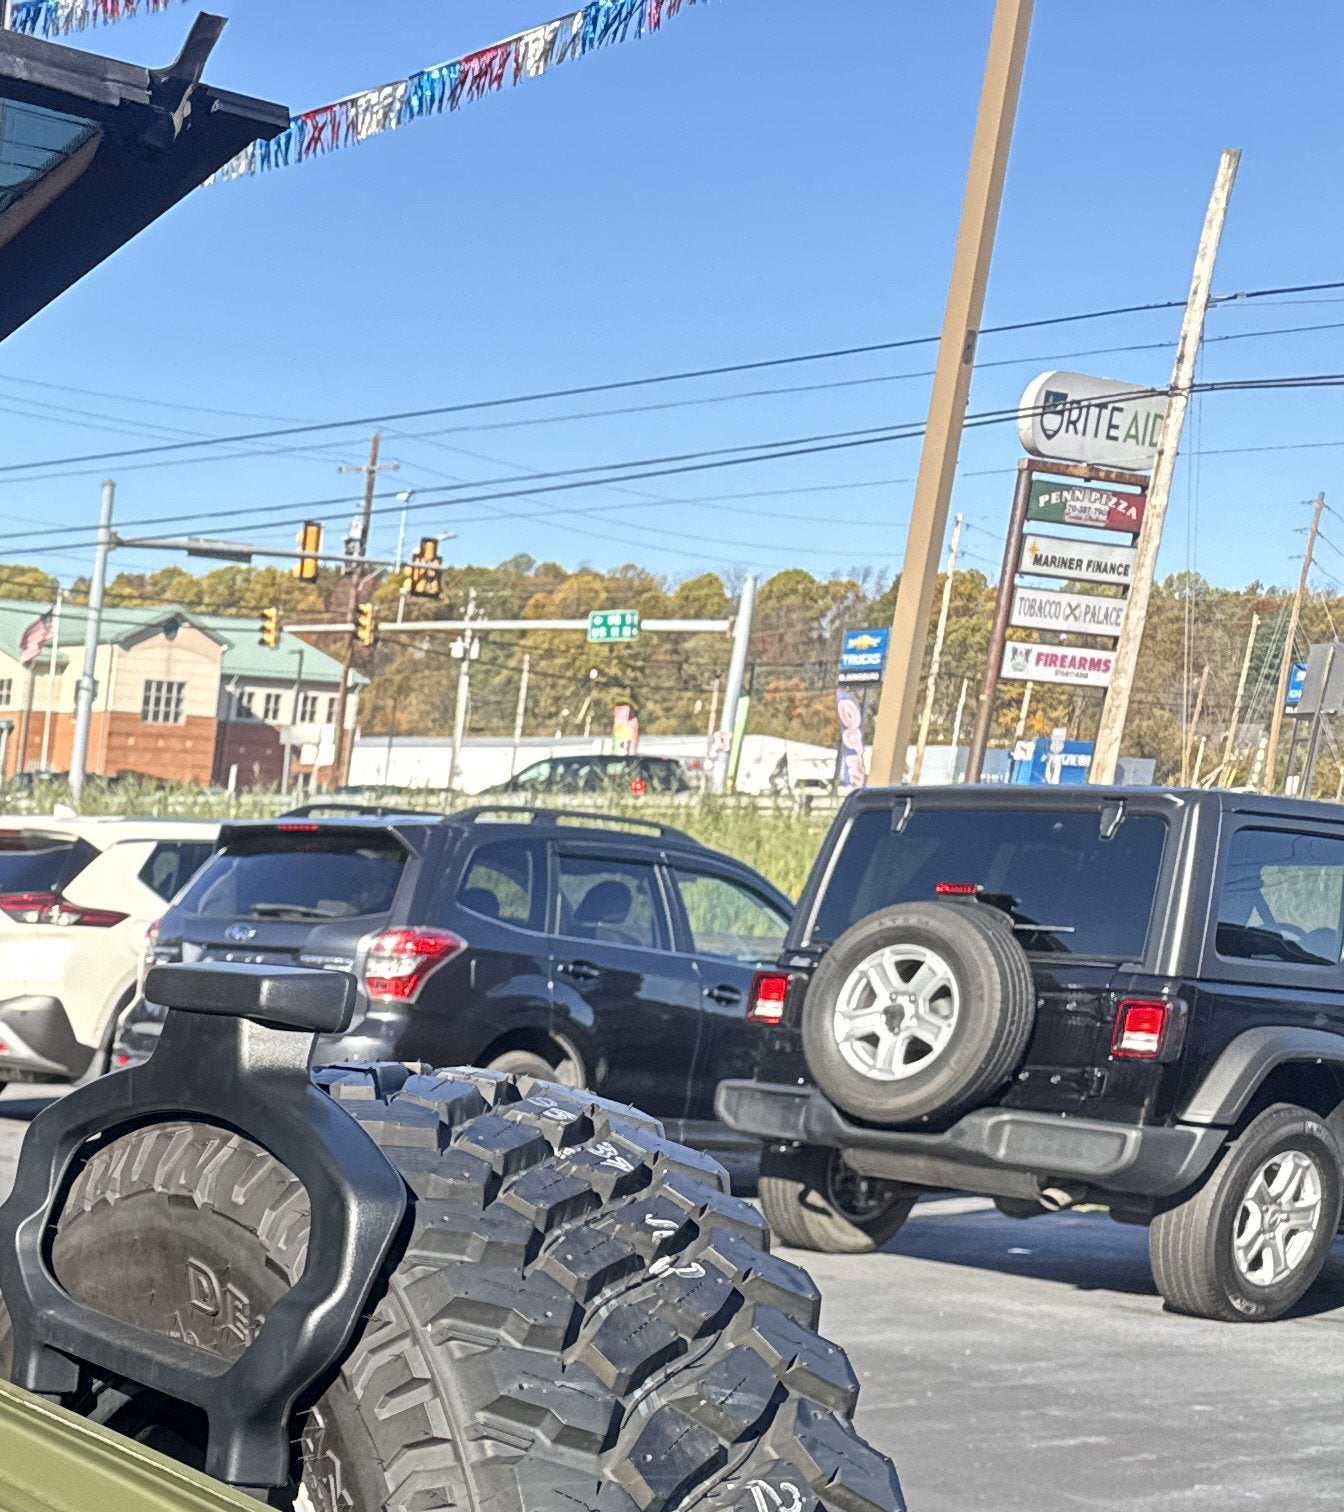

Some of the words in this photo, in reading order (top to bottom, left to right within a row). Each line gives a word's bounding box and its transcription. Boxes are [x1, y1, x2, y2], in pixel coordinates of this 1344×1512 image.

[1065, 399, 1124, 441] RITE
[1038, 489, 1085, 508] PENN
[1090, 491, 1138, 520] PIZZA
[1032, 553, 1083, 572] MARINER
[1086, 559, 1131, 577] FINANCE
[1018, 597, 1062, 620] TOBACCO
[1083, 603, 1124, 627] PALACE
[1035, 651, 1112, 674] FIREARMS
